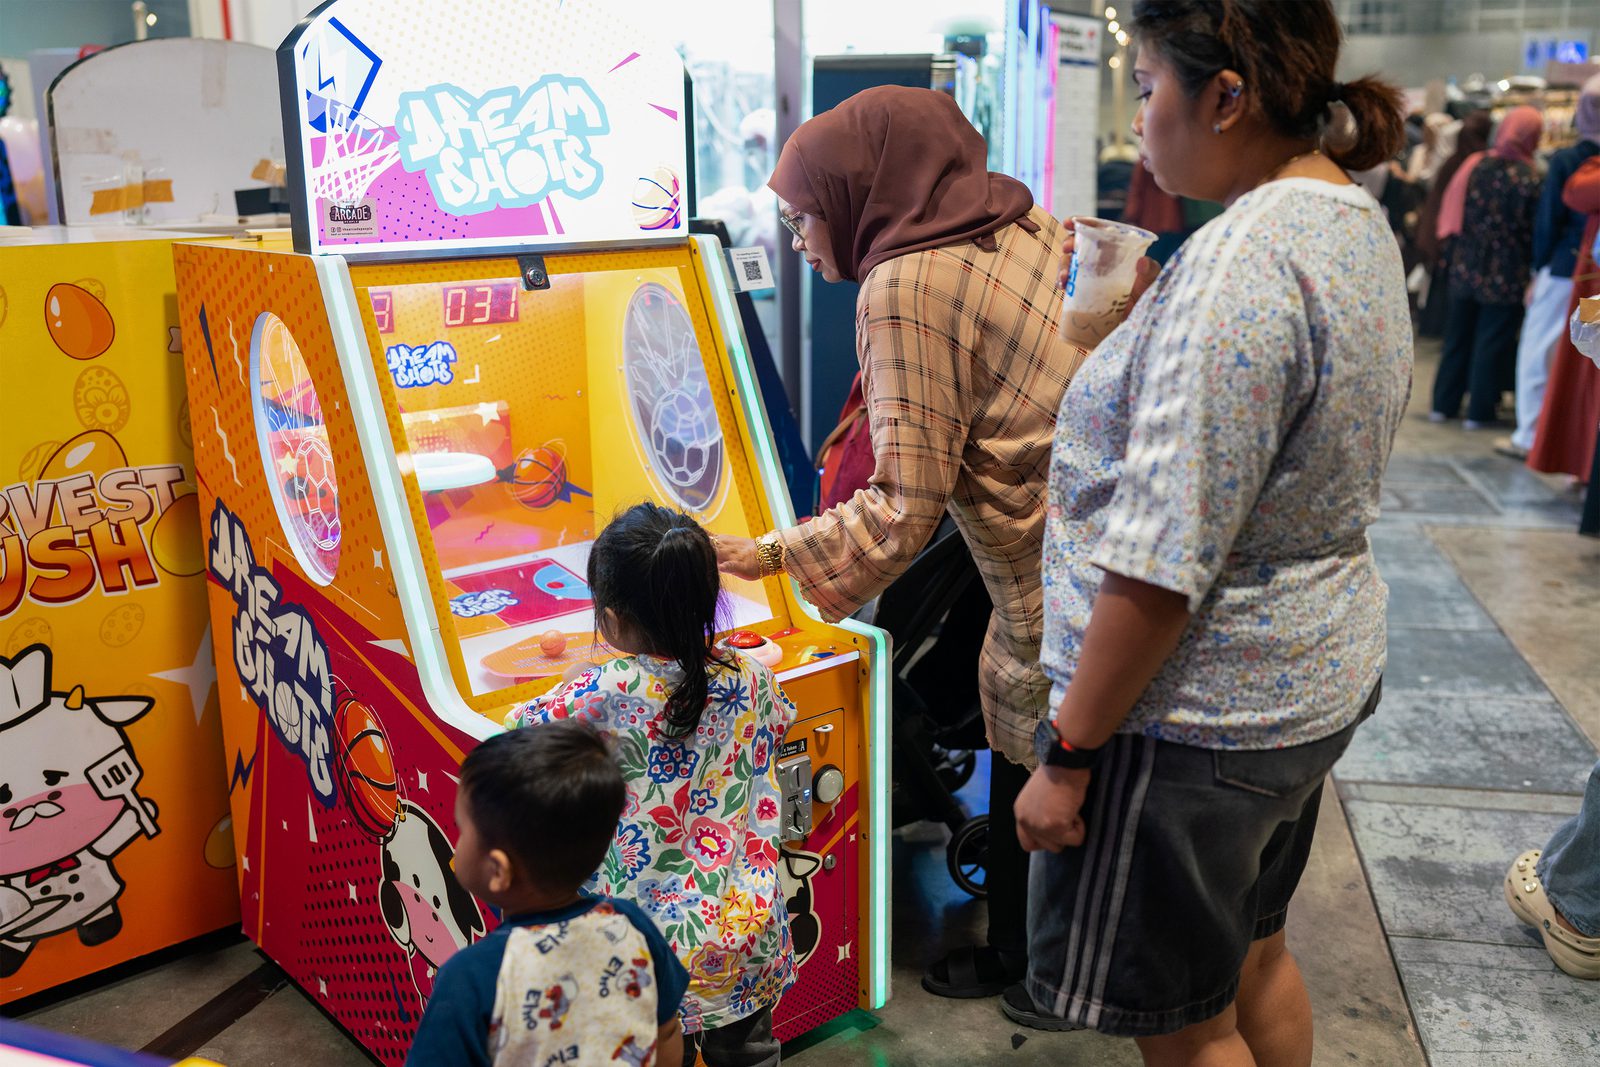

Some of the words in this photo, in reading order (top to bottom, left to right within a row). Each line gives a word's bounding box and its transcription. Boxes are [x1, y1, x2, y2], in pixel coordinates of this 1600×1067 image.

[401, 80, 604, 164] DREAM
[434, 128, 597, 208] SHOTS
[334, 206, 368, 221] ARCADE
[445, 286, 517, 325] 031
[387, 342, 456, 370] DREAM
[395, 359, 452, 388] SHOTS
[212, 506, 332, 716] DREAM
[236, 609, 334, 797] SHOTS
[535, 920, 569, 955] Elmo
[599, 956, 624, 998] Elmo
[522, 988, 542, 1031] Elmo
